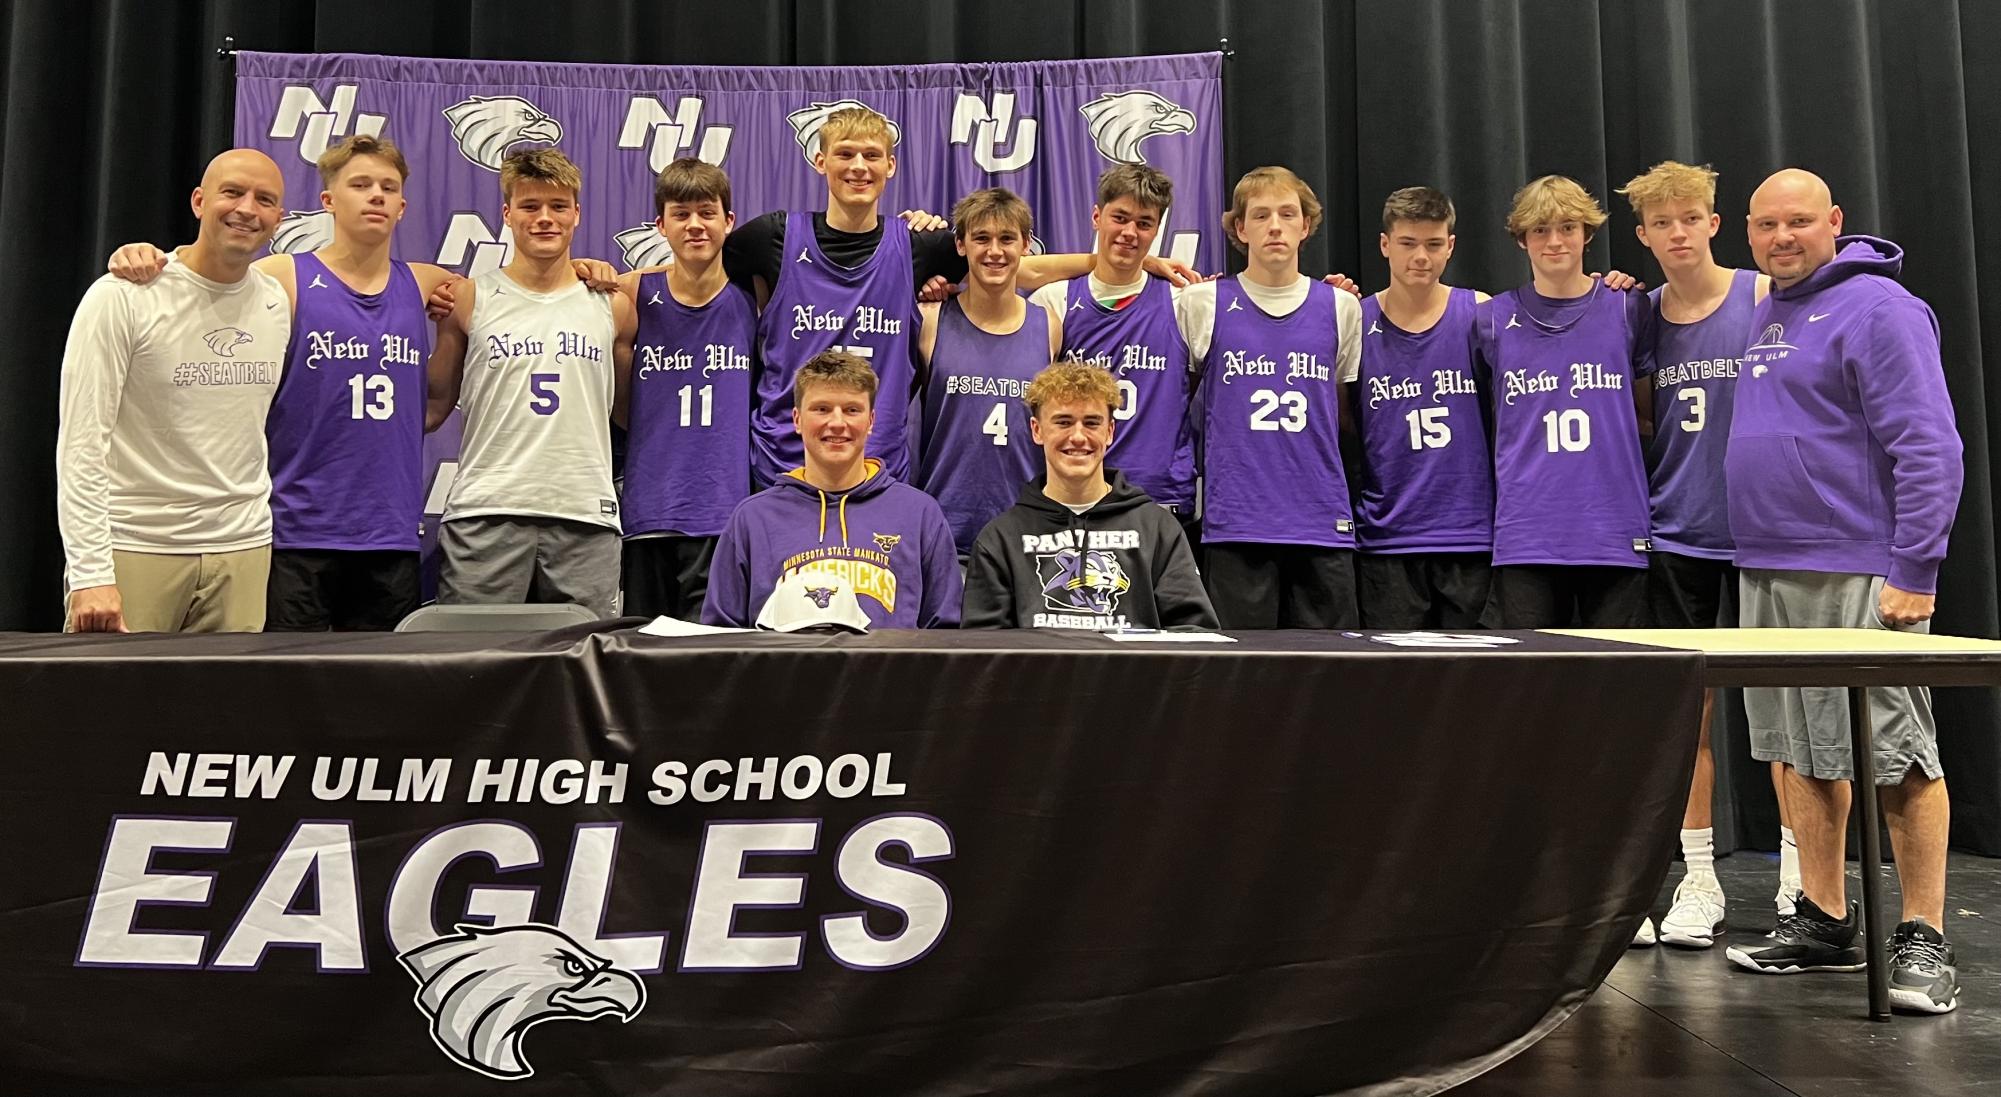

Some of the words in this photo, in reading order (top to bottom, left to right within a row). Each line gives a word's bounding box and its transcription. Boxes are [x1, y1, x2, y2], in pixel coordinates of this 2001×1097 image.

[949, 91, 1038, 173] NU
[791, 304, 844, 340] New
[852, 305, 901, 340] Ulm
[307, 330, 369, 370] New
[487, 331, 545, 369] New
[555, 331, 603, 364] Ulm
[639, 344, 693, 380] New
[702, 344, 750, 379] Ulm
[1118, 344, 1167, 376] Ulm
[1223, 350, 1276, 384] New
[1286, 351, 1330, 386] Ulm
[1766, 350, 1788, 361] ULM
[530, 373, 560, 416] 5
[1368, 375, 1422, 410] New
[1504, 368, 1559, 405] New
[1569, 363, 1623, 398] Ulm
[1656, 359, 1743, 389] SEATBELT
[348, 373, 394, 420] 13
[678, 384, 713, 427] 11
[1250, 389, 1308, 433] 23
[1677, 387, 1706, 432] 3
[983, 402, 1009, 446] 4
[1405, 406, 1452, 450] 15
[1543, 409, 1591, 453] 10
[783, 548, 825, 571] MINNESOTA
[827, 546, 851, 557] STATE
[854, 547, 890, 566] MANKATO
[1022, 529, 1140, 553] PANTHER
[1033, 613, 1131, 629] BASEBALL
[140, 751, 296, 799] NEW
[311, 756, 452, 802] ULM
[467, 758, 629, 804] HIGH
[648, 752, 907, 806] SCHOOL
[74, 811, 957, 974] EAGLES
